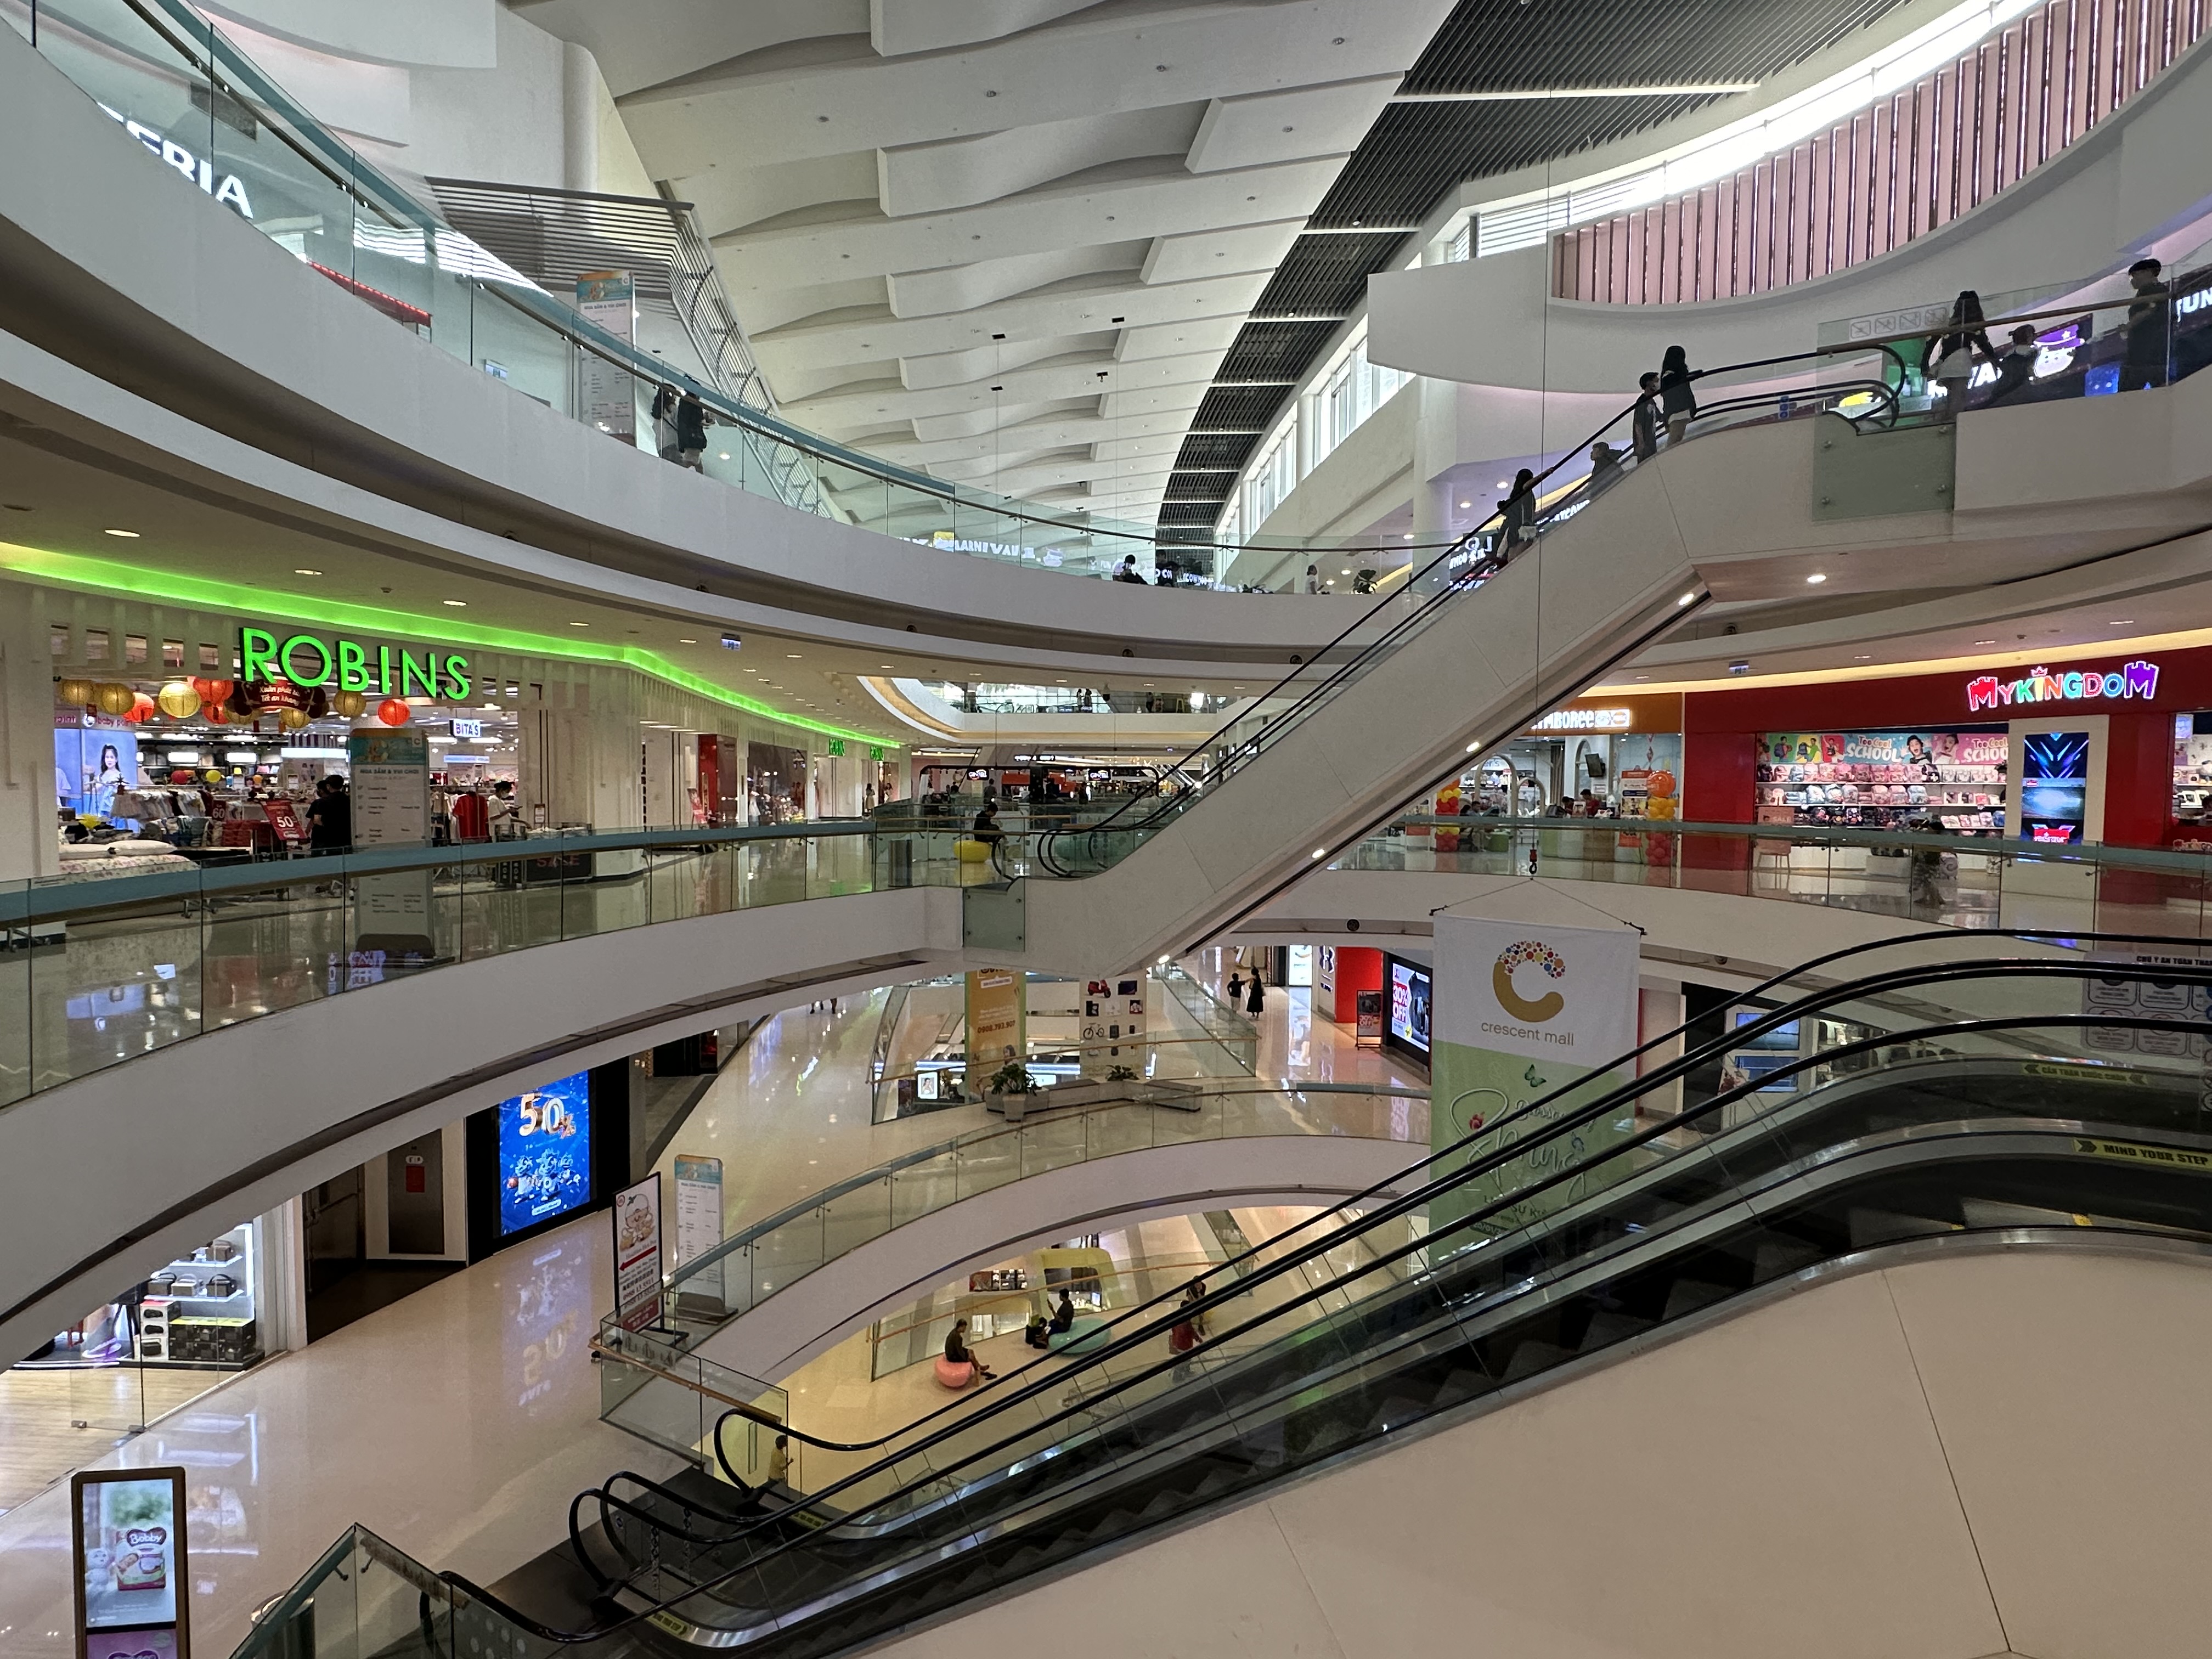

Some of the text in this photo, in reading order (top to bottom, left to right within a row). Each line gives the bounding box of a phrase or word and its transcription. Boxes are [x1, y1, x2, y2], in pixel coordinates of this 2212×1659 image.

[97, 101, 253, 219] ERIA
[239, 627, 470, 700] ROBINS
[455, 721, 479, 736] BITA'S
[1846, 743, 1902, 763] SCHOOL
[1481, 1022, 1574, 1046] crescent mall
[2103, 1144, 2209, 1166] MIND YOUR STEP
[131, 1533, 162, 1544] Bobby
